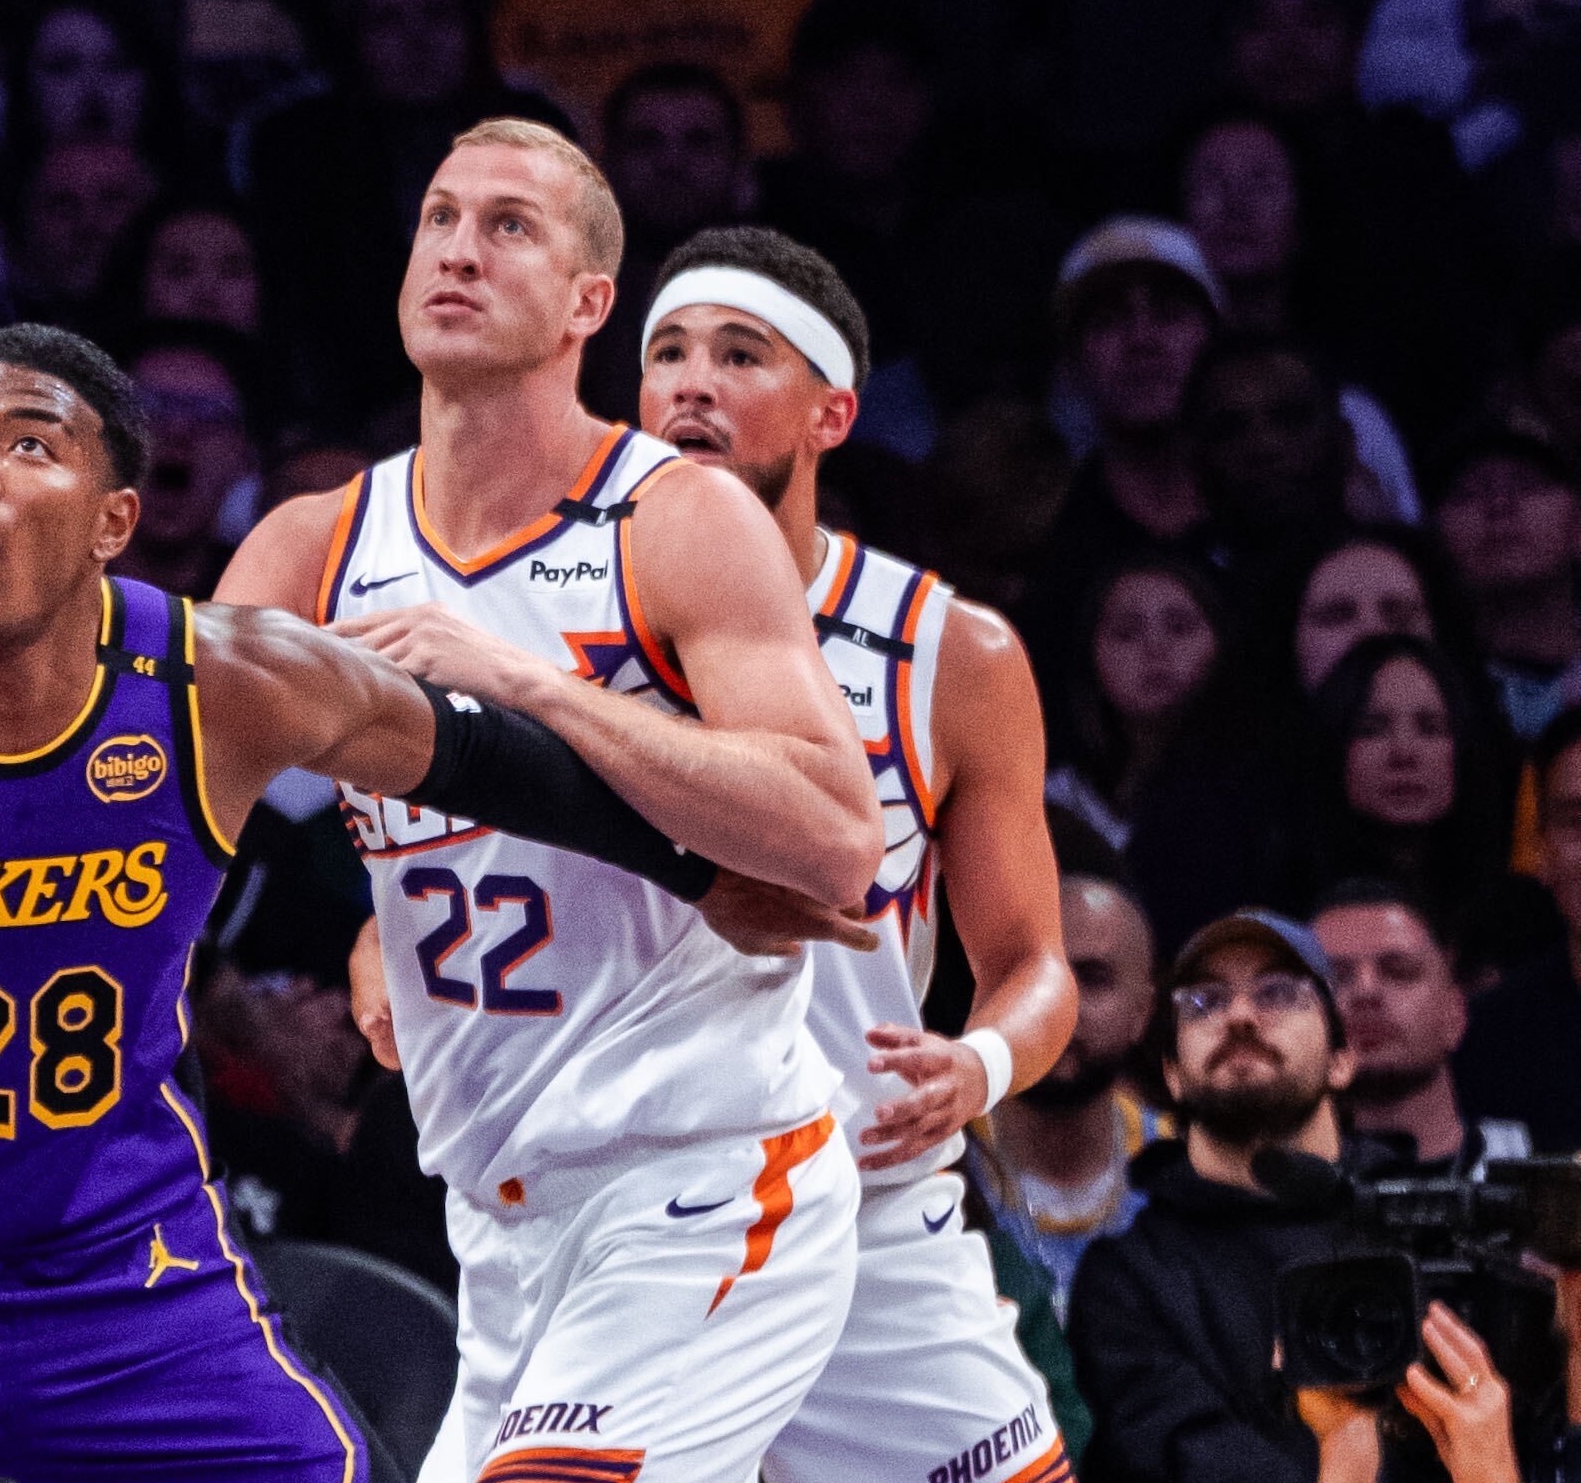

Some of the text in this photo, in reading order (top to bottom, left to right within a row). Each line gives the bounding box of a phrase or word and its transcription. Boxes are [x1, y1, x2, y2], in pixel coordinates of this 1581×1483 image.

[529, 558, 609, 589] PayPal
[94, 752, 162, 781] bibigo
[400, 867, 564, 1016] 22
[494, 1402, 615, 1449] OENIX
